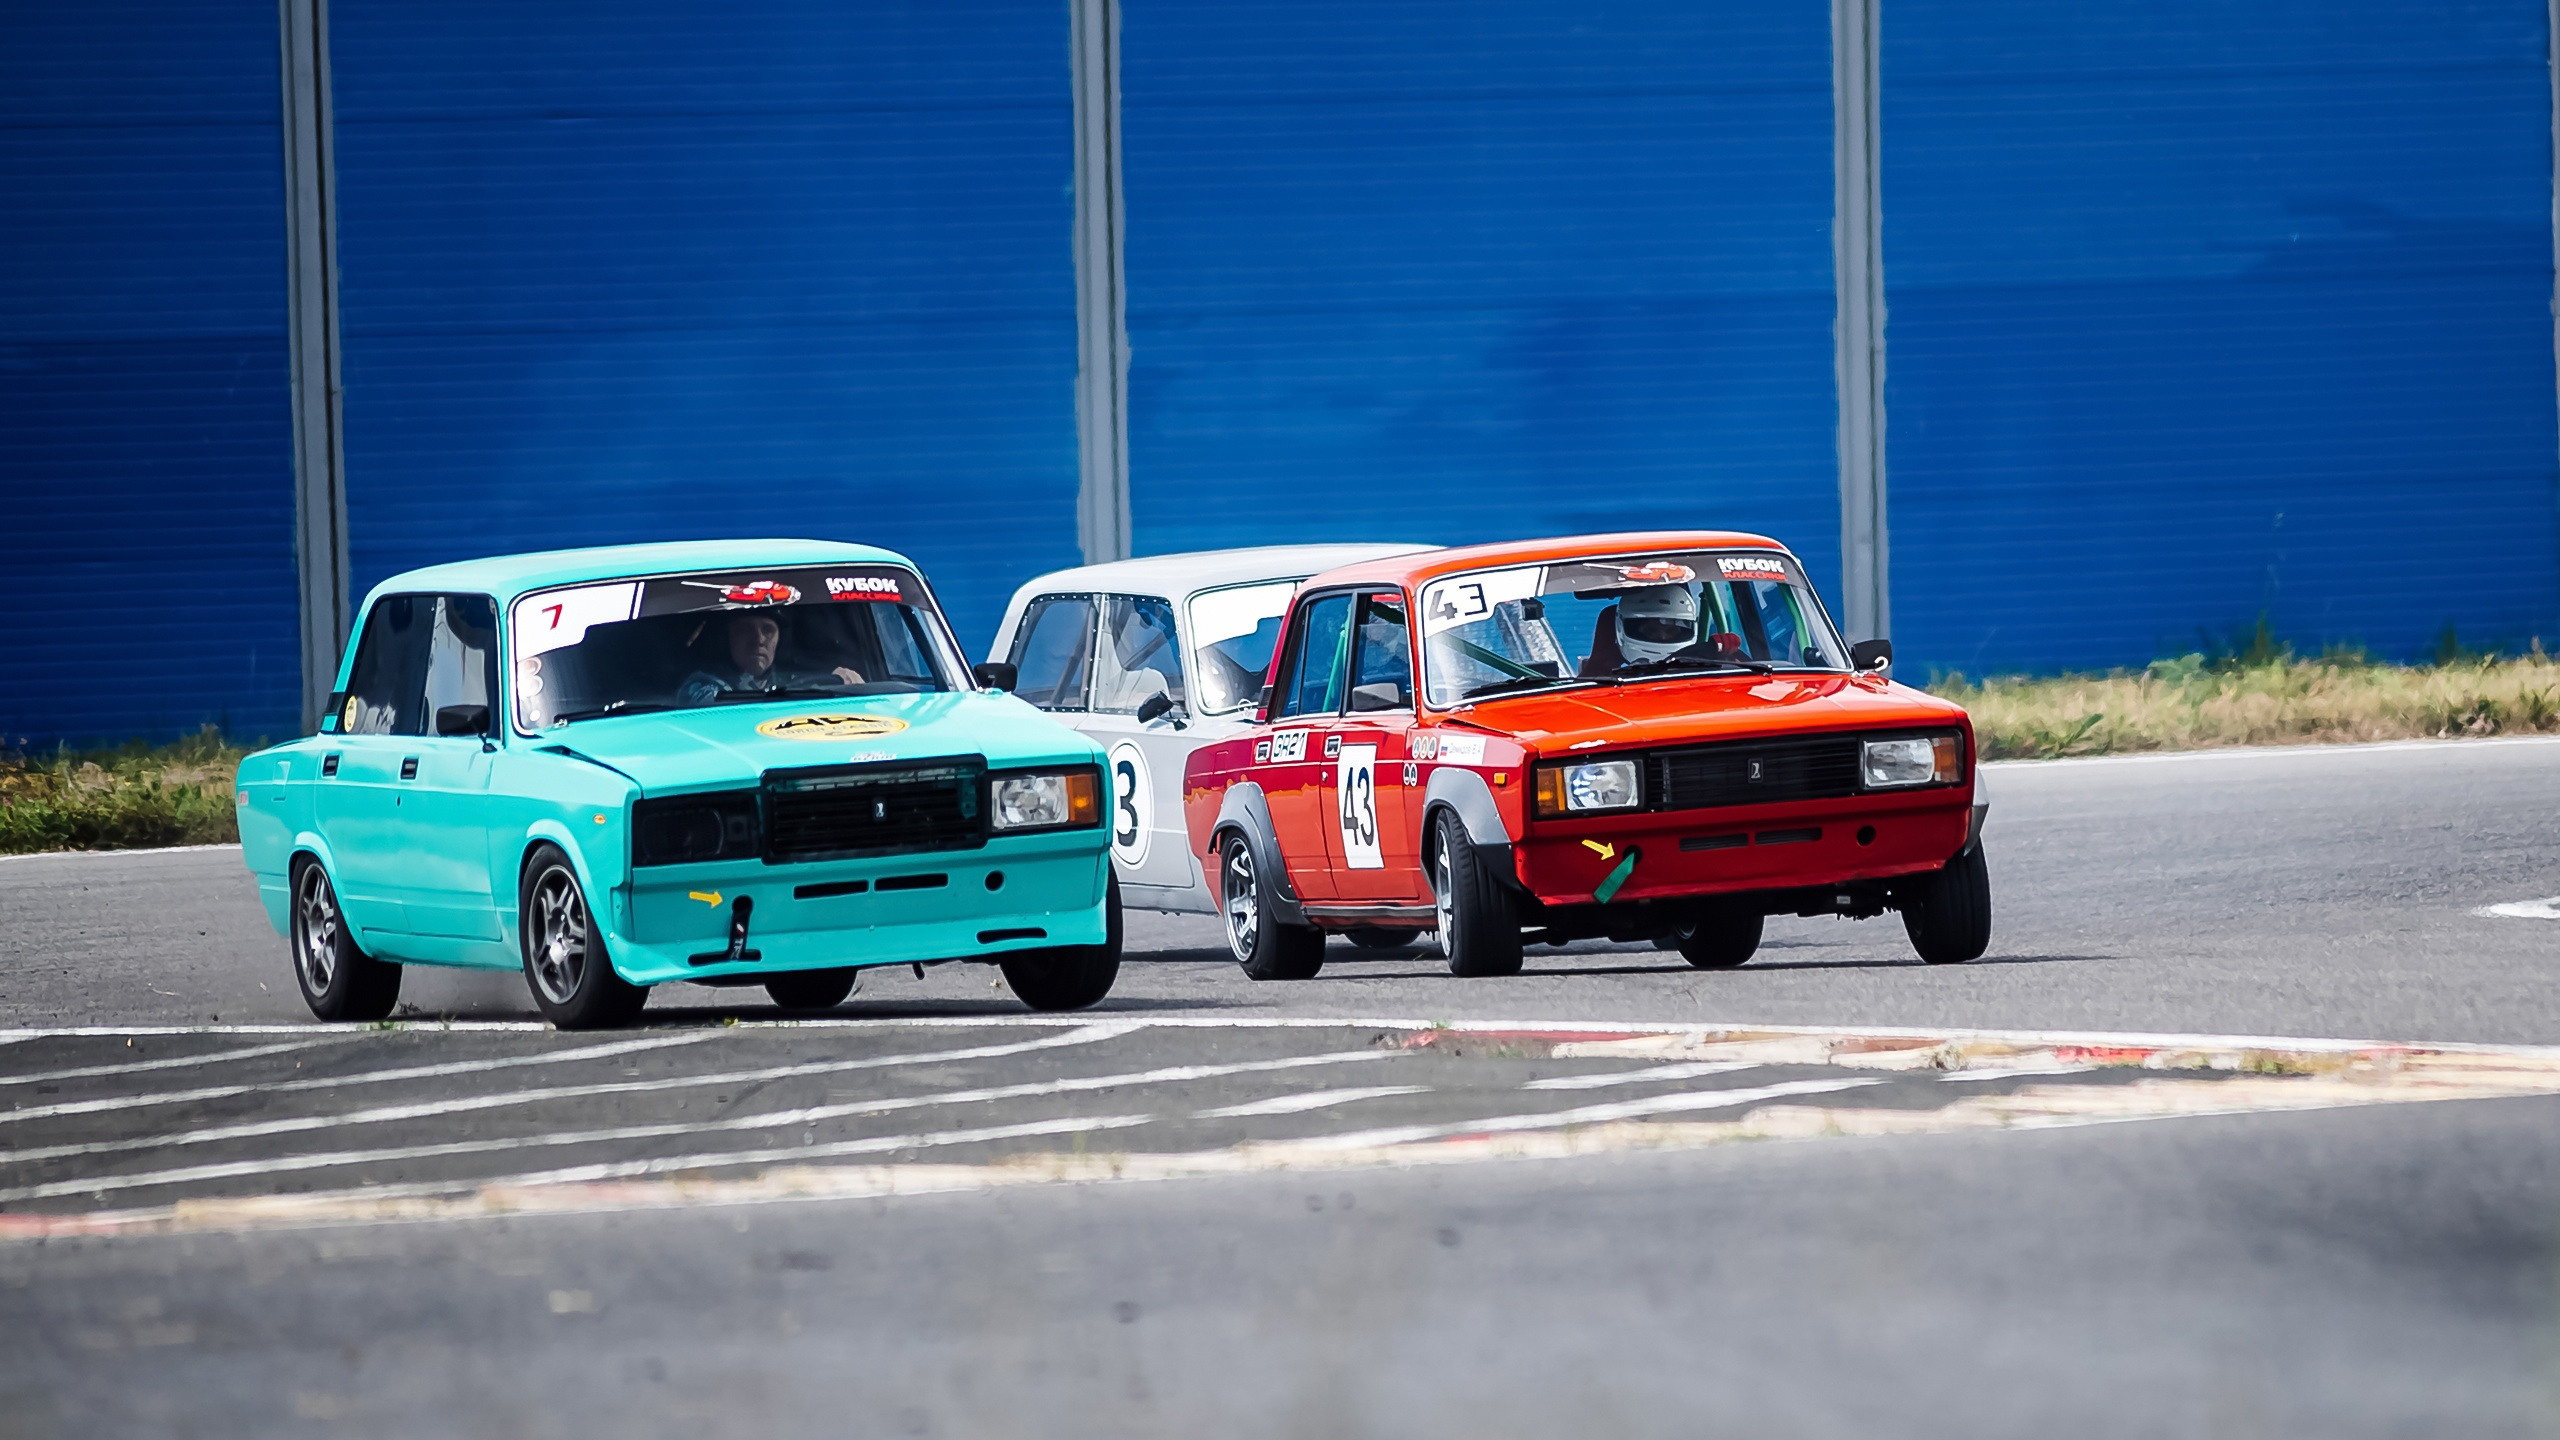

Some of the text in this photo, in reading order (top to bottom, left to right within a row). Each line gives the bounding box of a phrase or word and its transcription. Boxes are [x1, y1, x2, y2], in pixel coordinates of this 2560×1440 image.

[1717, 558, 1785, 574] КУБОК
[826, 577, 899, 594] КУБОК
[1428, 583, 1488, 620] 43
[541, 603, 563, 630] 7
[1116, 759, 1139, 848] 3
[1343, 765, 1375, 847] 43
